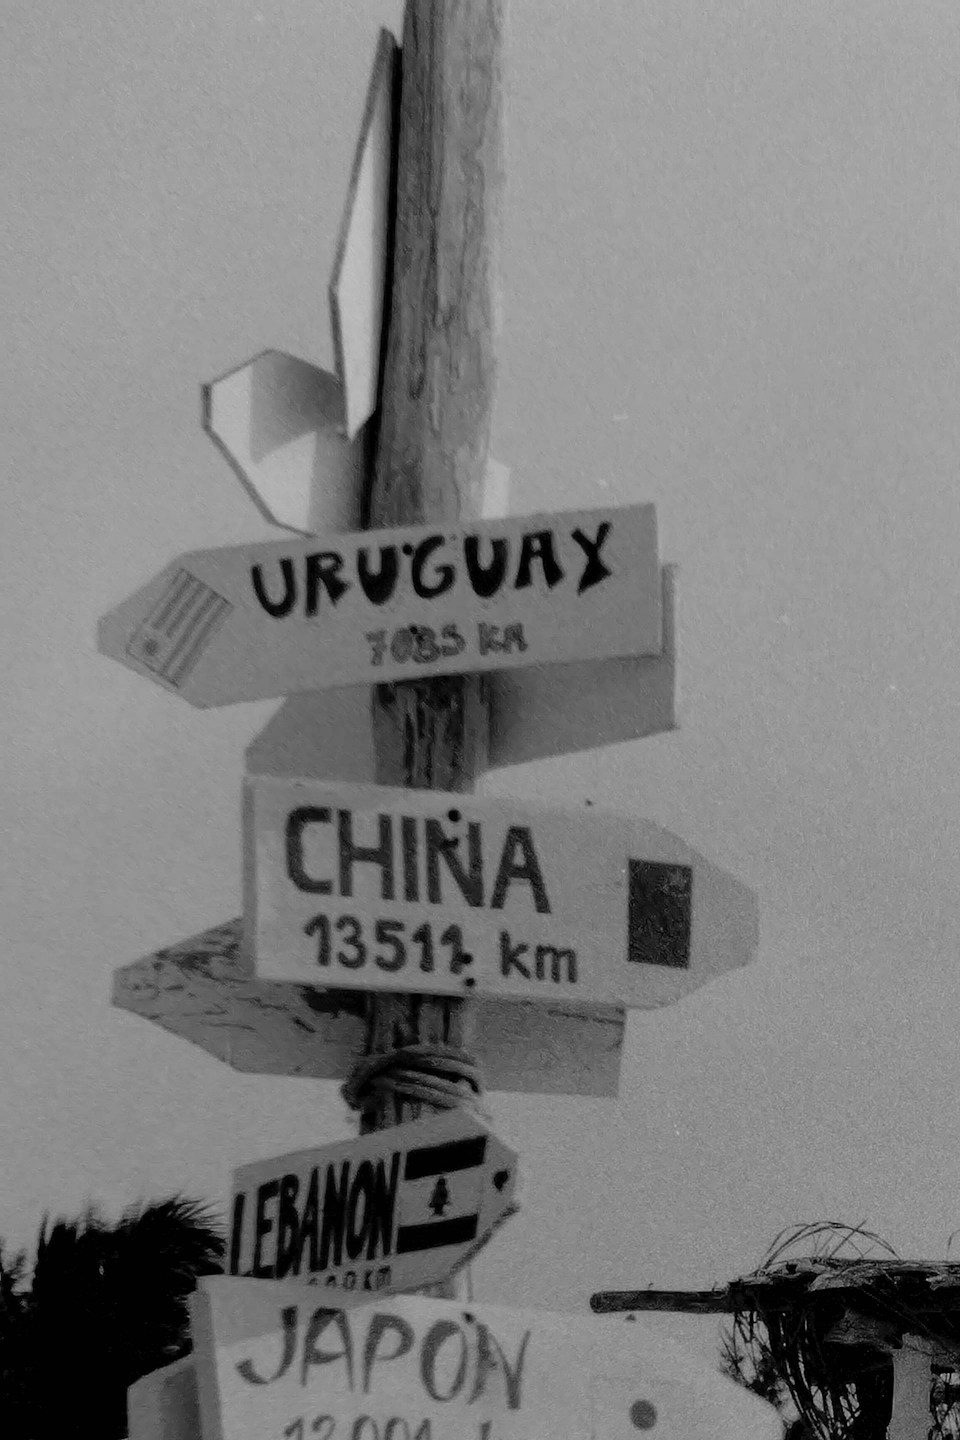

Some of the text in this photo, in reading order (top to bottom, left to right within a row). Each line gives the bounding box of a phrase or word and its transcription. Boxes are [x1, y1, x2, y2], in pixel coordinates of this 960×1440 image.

[251, 522, 612, 618] URUGUAY
[285, 806, 551, 914] CHINA
[303, 914, 578, 984] 13511 km
[230, 1152, 401, 1279] LEBANON
[234, 1305, 530, 1409] JAPON
